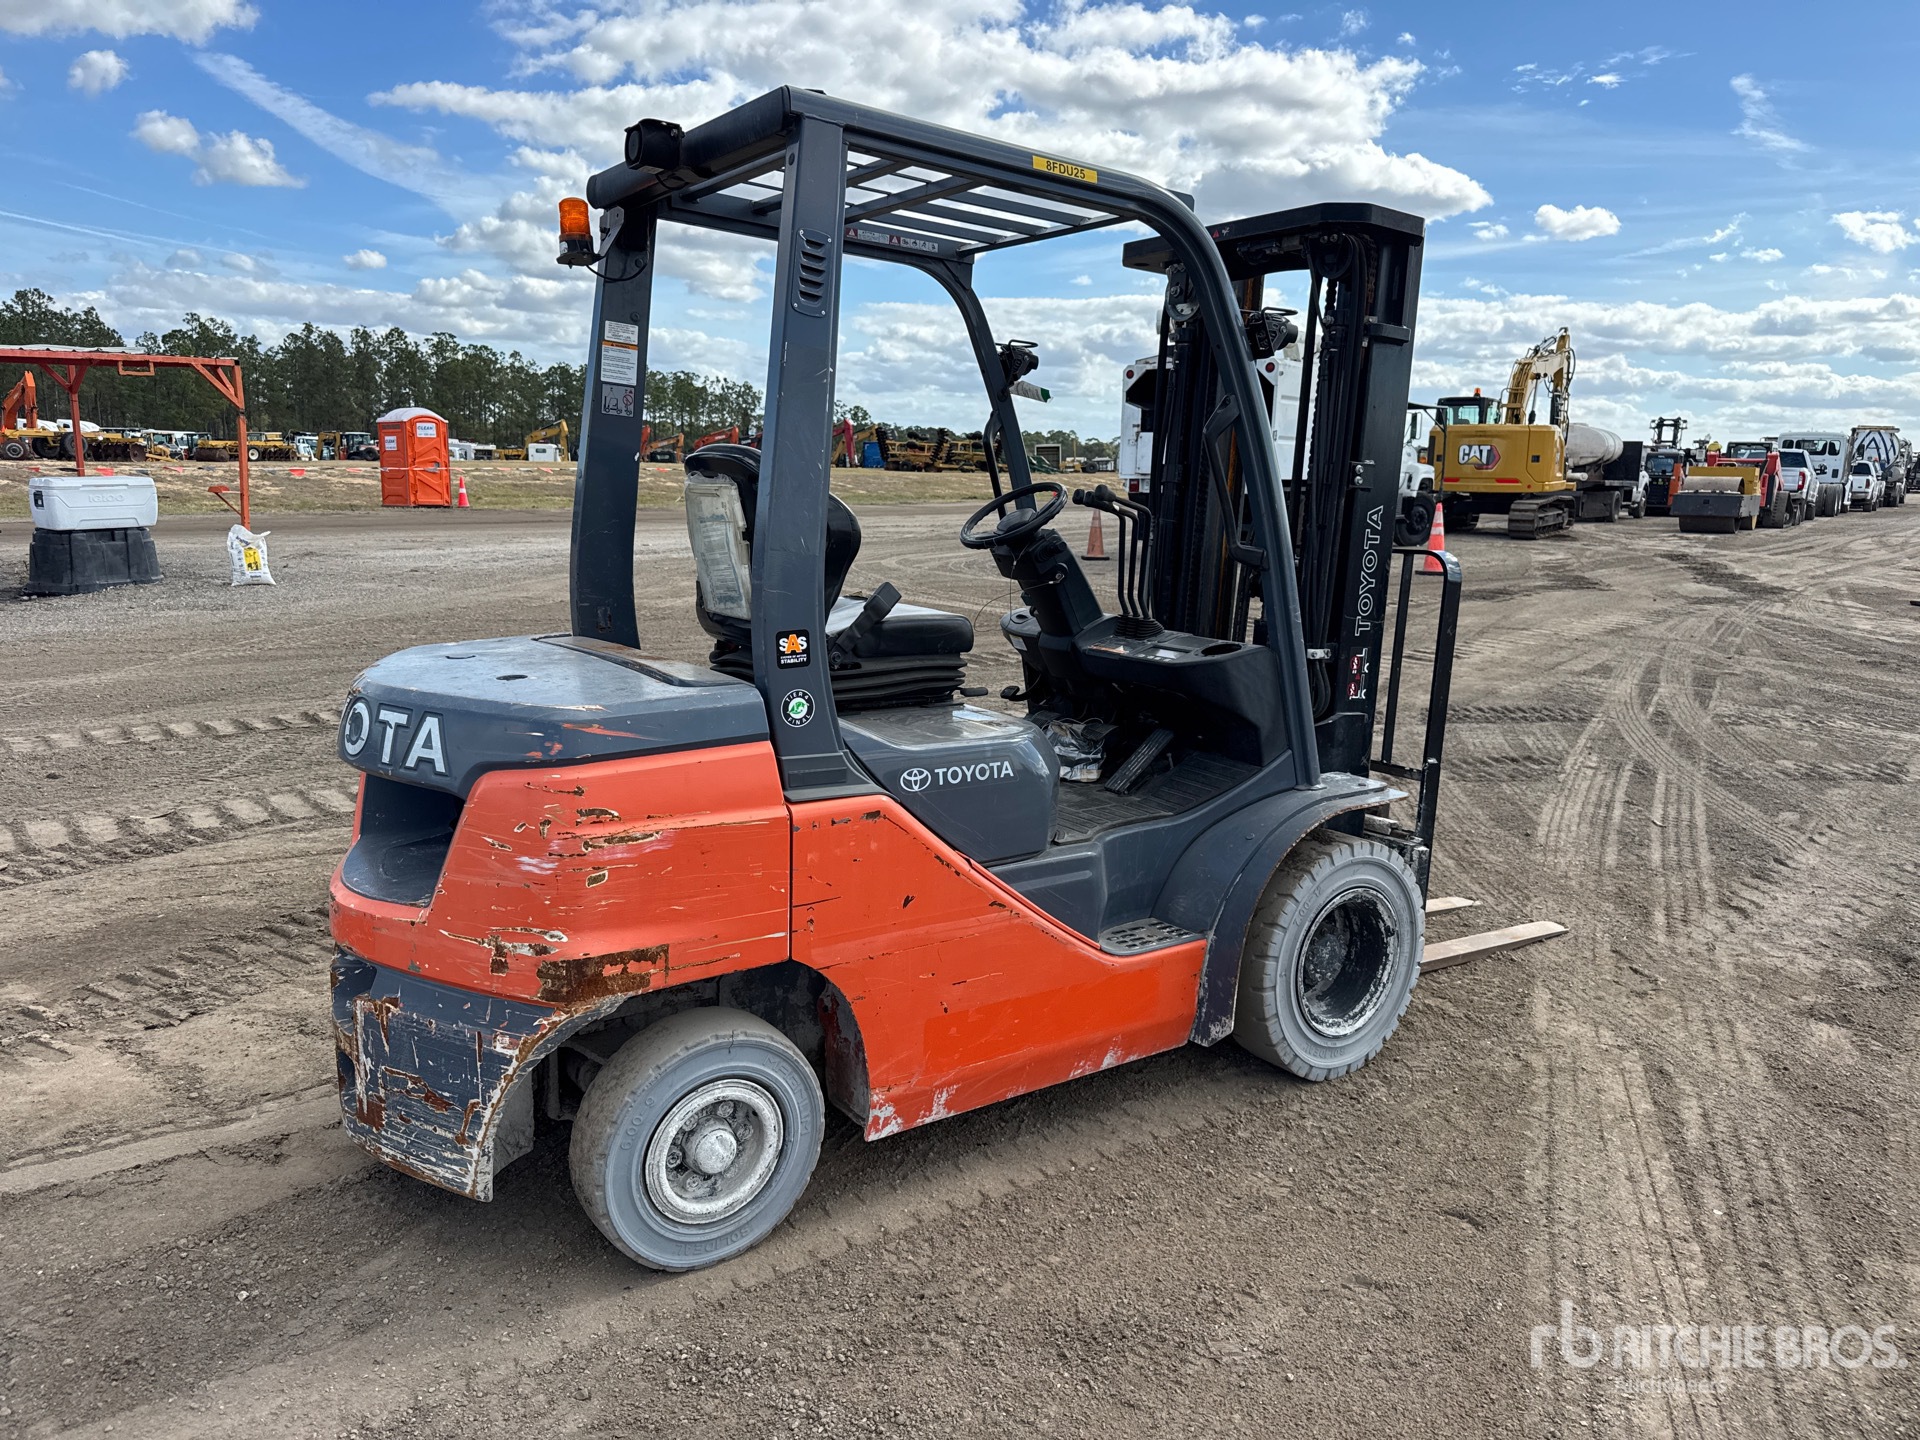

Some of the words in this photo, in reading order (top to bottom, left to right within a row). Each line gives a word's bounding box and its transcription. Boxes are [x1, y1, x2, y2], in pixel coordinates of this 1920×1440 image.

[1045, 160, 1086, 180] 8FDU25
[1458, 444, 1492, 465] CAT
[1355, 504, 1384, 637] TOYOTA
[779, 633, 808, 654] SAS
[780, 657, 807, 665] STABILITY
[785, 691, 803, 702] TIER
[787, 714, 811, 726] FINAL
[344, 700, 446, 774] OTA
[934, 760, 1014, 786] TOYOTA
